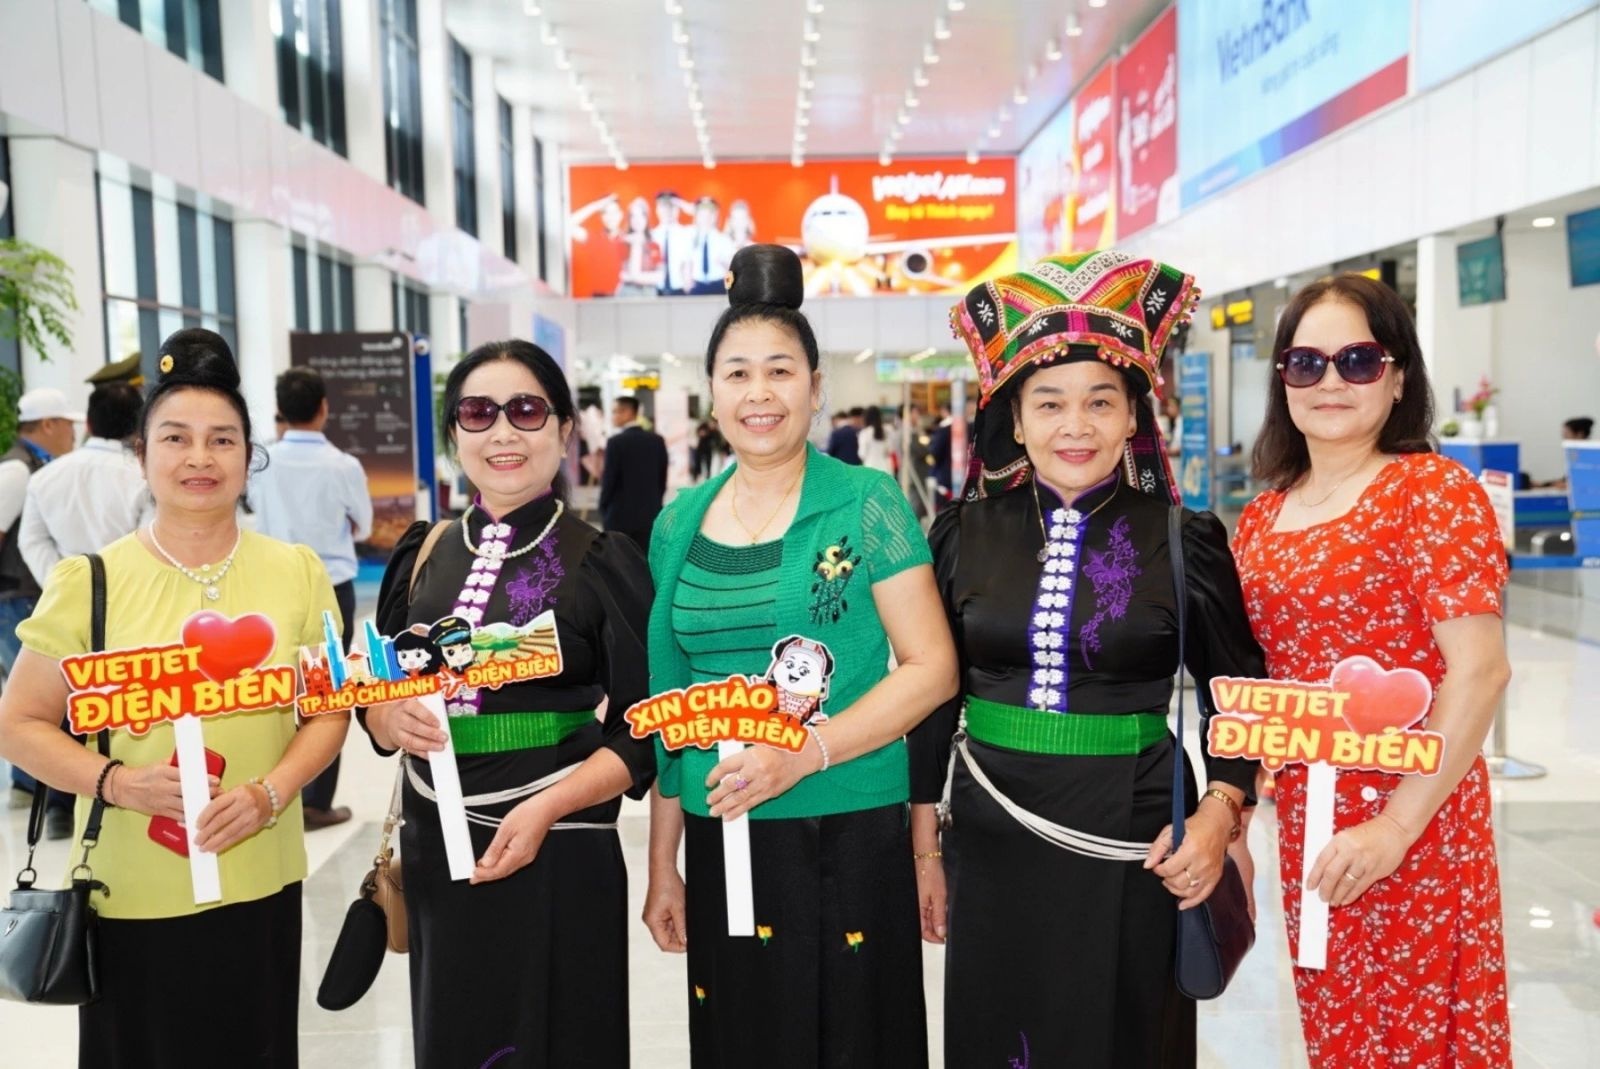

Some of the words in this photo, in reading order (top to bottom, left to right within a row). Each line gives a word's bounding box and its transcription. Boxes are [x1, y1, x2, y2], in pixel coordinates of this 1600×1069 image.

[67, 644, 203, 687] VIETJET
[467, 664, 513, 688] ĐIỆN
[515, 652, 559, 676] BIÊN
[74, 682, 182, 730] ĐIỆN
[192, 667, 292, 713] BIÊN
[356, 681, 387, 705] CHÍ
[389, 677, 436, 699] MINH
[631, 695, 682, 733] XIN
[688, 681, 774, 713] CHÀO
[1217, 682, 1351, 719] VIETJET
[666, 713, 730, 744] ĐIỆN
[737, 717, 805, 749] BIÊN
[1215, 716, 1321, 766] ĐIỆN
[1331, 726, 1438, 771] BIÊN
